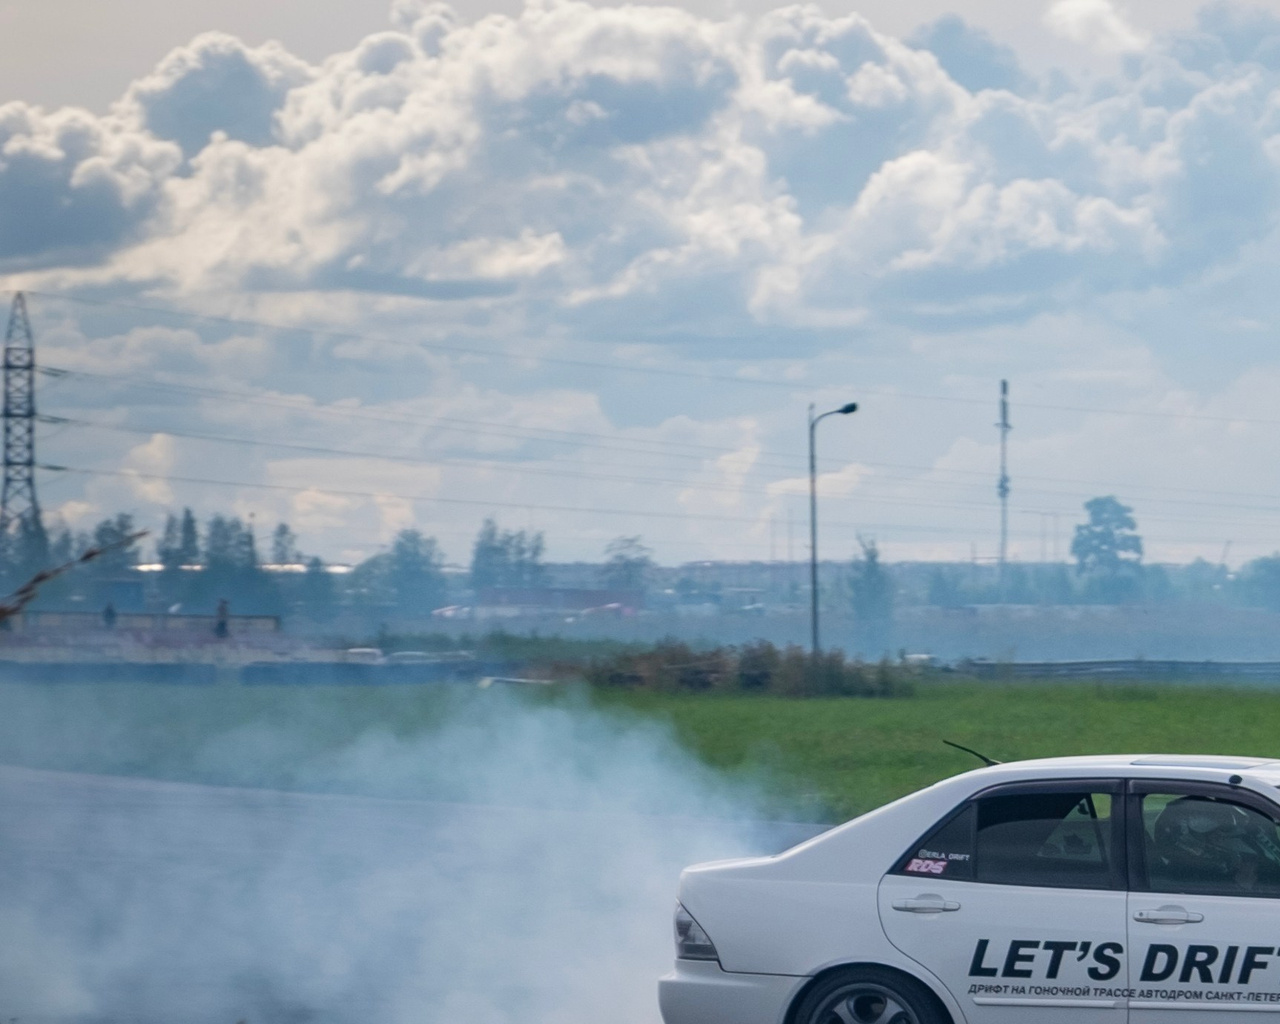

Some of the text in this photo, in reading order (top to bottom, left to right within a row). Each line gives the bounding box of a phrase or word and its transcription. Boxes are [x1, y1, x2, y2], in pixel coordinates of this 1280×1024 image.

[907, 859, 947, 874] RDS
[968, 939, 1124, 981] LET'S
[967, 984, 1009, 995] ДРИФТ
[1011, 985, 1026, 995] НА
[1028, 985, 1090, 997] ГОНОЧНОЙ
[1093, 987, 1136, 998] ТРАССЕ
[1137, 988, 1203, 1000] АВТОДРОМ
